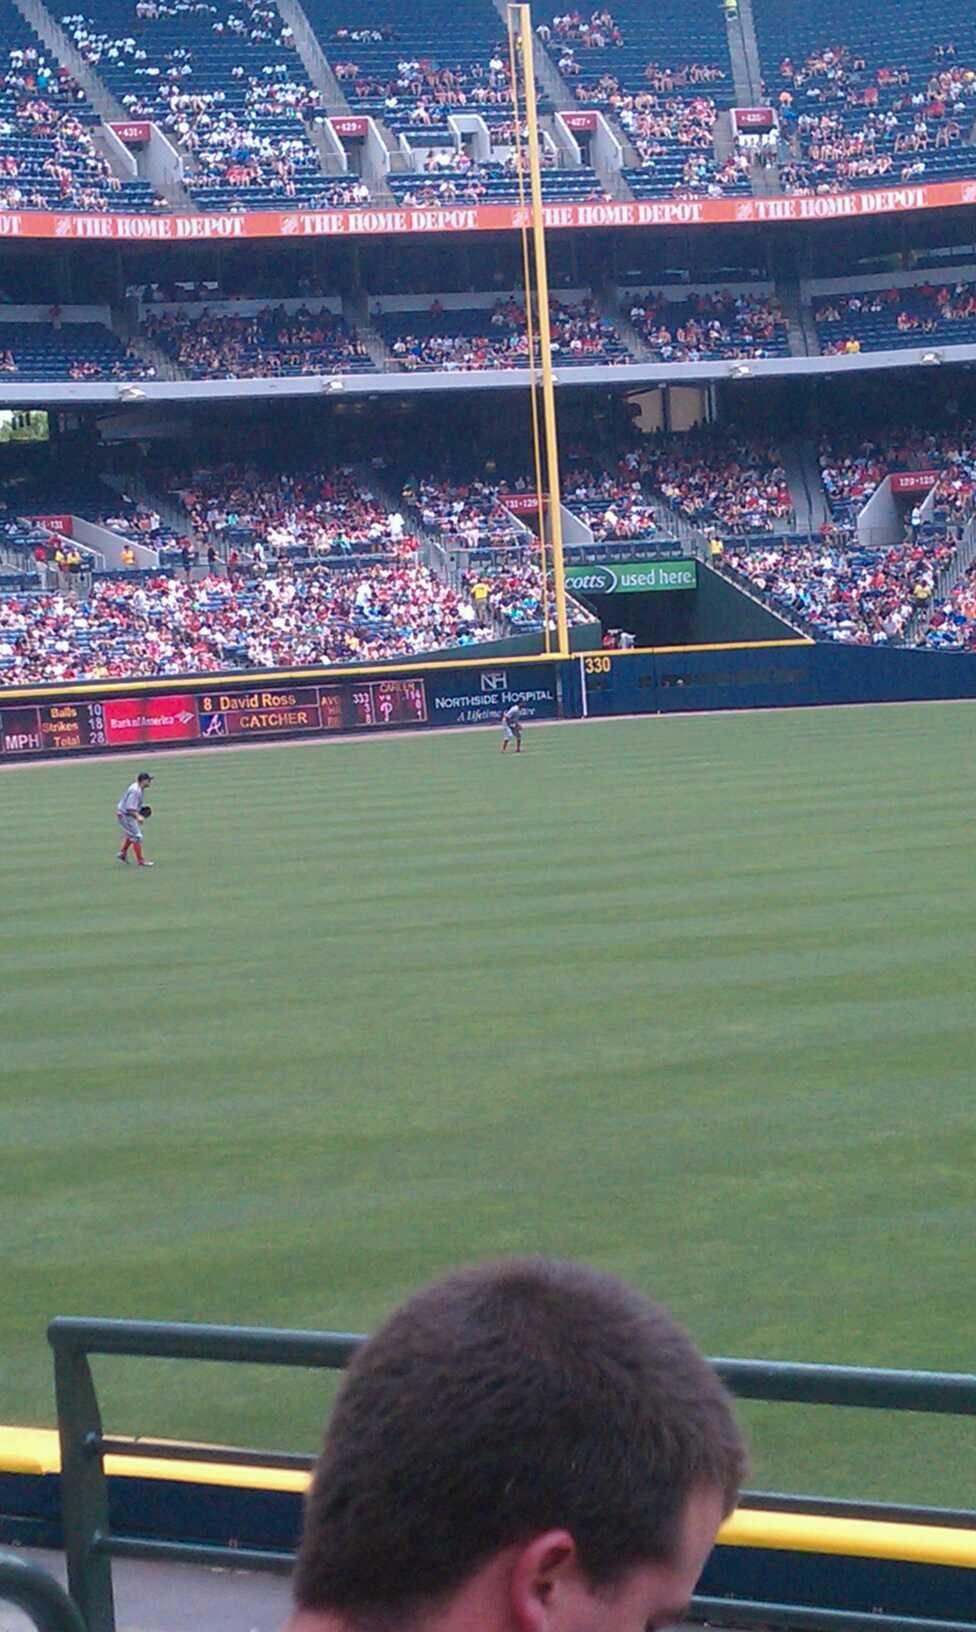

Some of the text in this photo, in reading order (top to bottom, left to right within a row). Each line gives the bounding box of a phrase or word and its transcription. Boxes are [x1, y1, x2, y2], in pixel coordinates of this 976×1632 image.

[755, 188, 928, 219] THE HOME DEPOT
[300, 210, 478, 233] THE HOME DEPOT
[577, 206, 632, 225] HOME
[637, 203, 703, 222] DEPOT
[72, 217, 244, 238] THE HOME DEPOT
[563, 569, 696, 589] cotts used here.
[585, 657, 611, 673] 330
[203, 692, 297, 711] 8 David Ross
[435, 690, 553, 709] NORTHSIDE HOSPITAL
[50, 703, 102, 719] Balls 10
[240, 711, 308, 729] CATCHER
[88, 717, 104, 731] 18
[5, 733, 40, 750] MPH
[53, 731, 105, 747] Total 28
